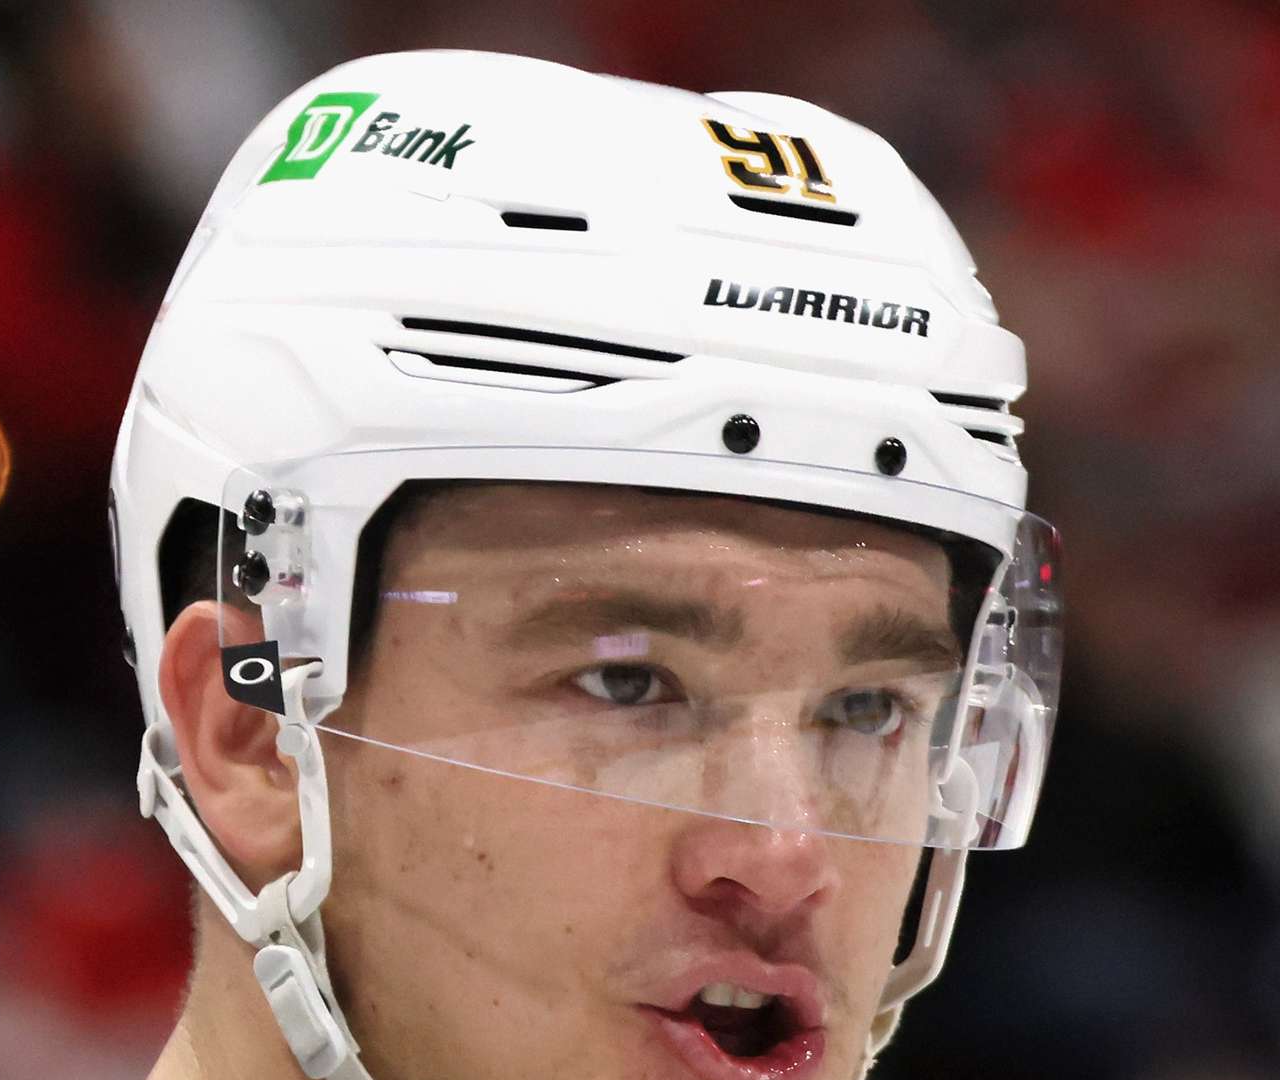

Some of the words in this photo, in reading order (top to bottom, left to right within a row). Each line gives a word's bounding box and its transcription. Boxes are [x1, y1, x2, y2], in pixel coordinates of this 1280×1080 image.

[350, 111, 475, 170] Bank
[699, 117, 837, 204] 91
[703, 278, 931, 338] WARRIOR
